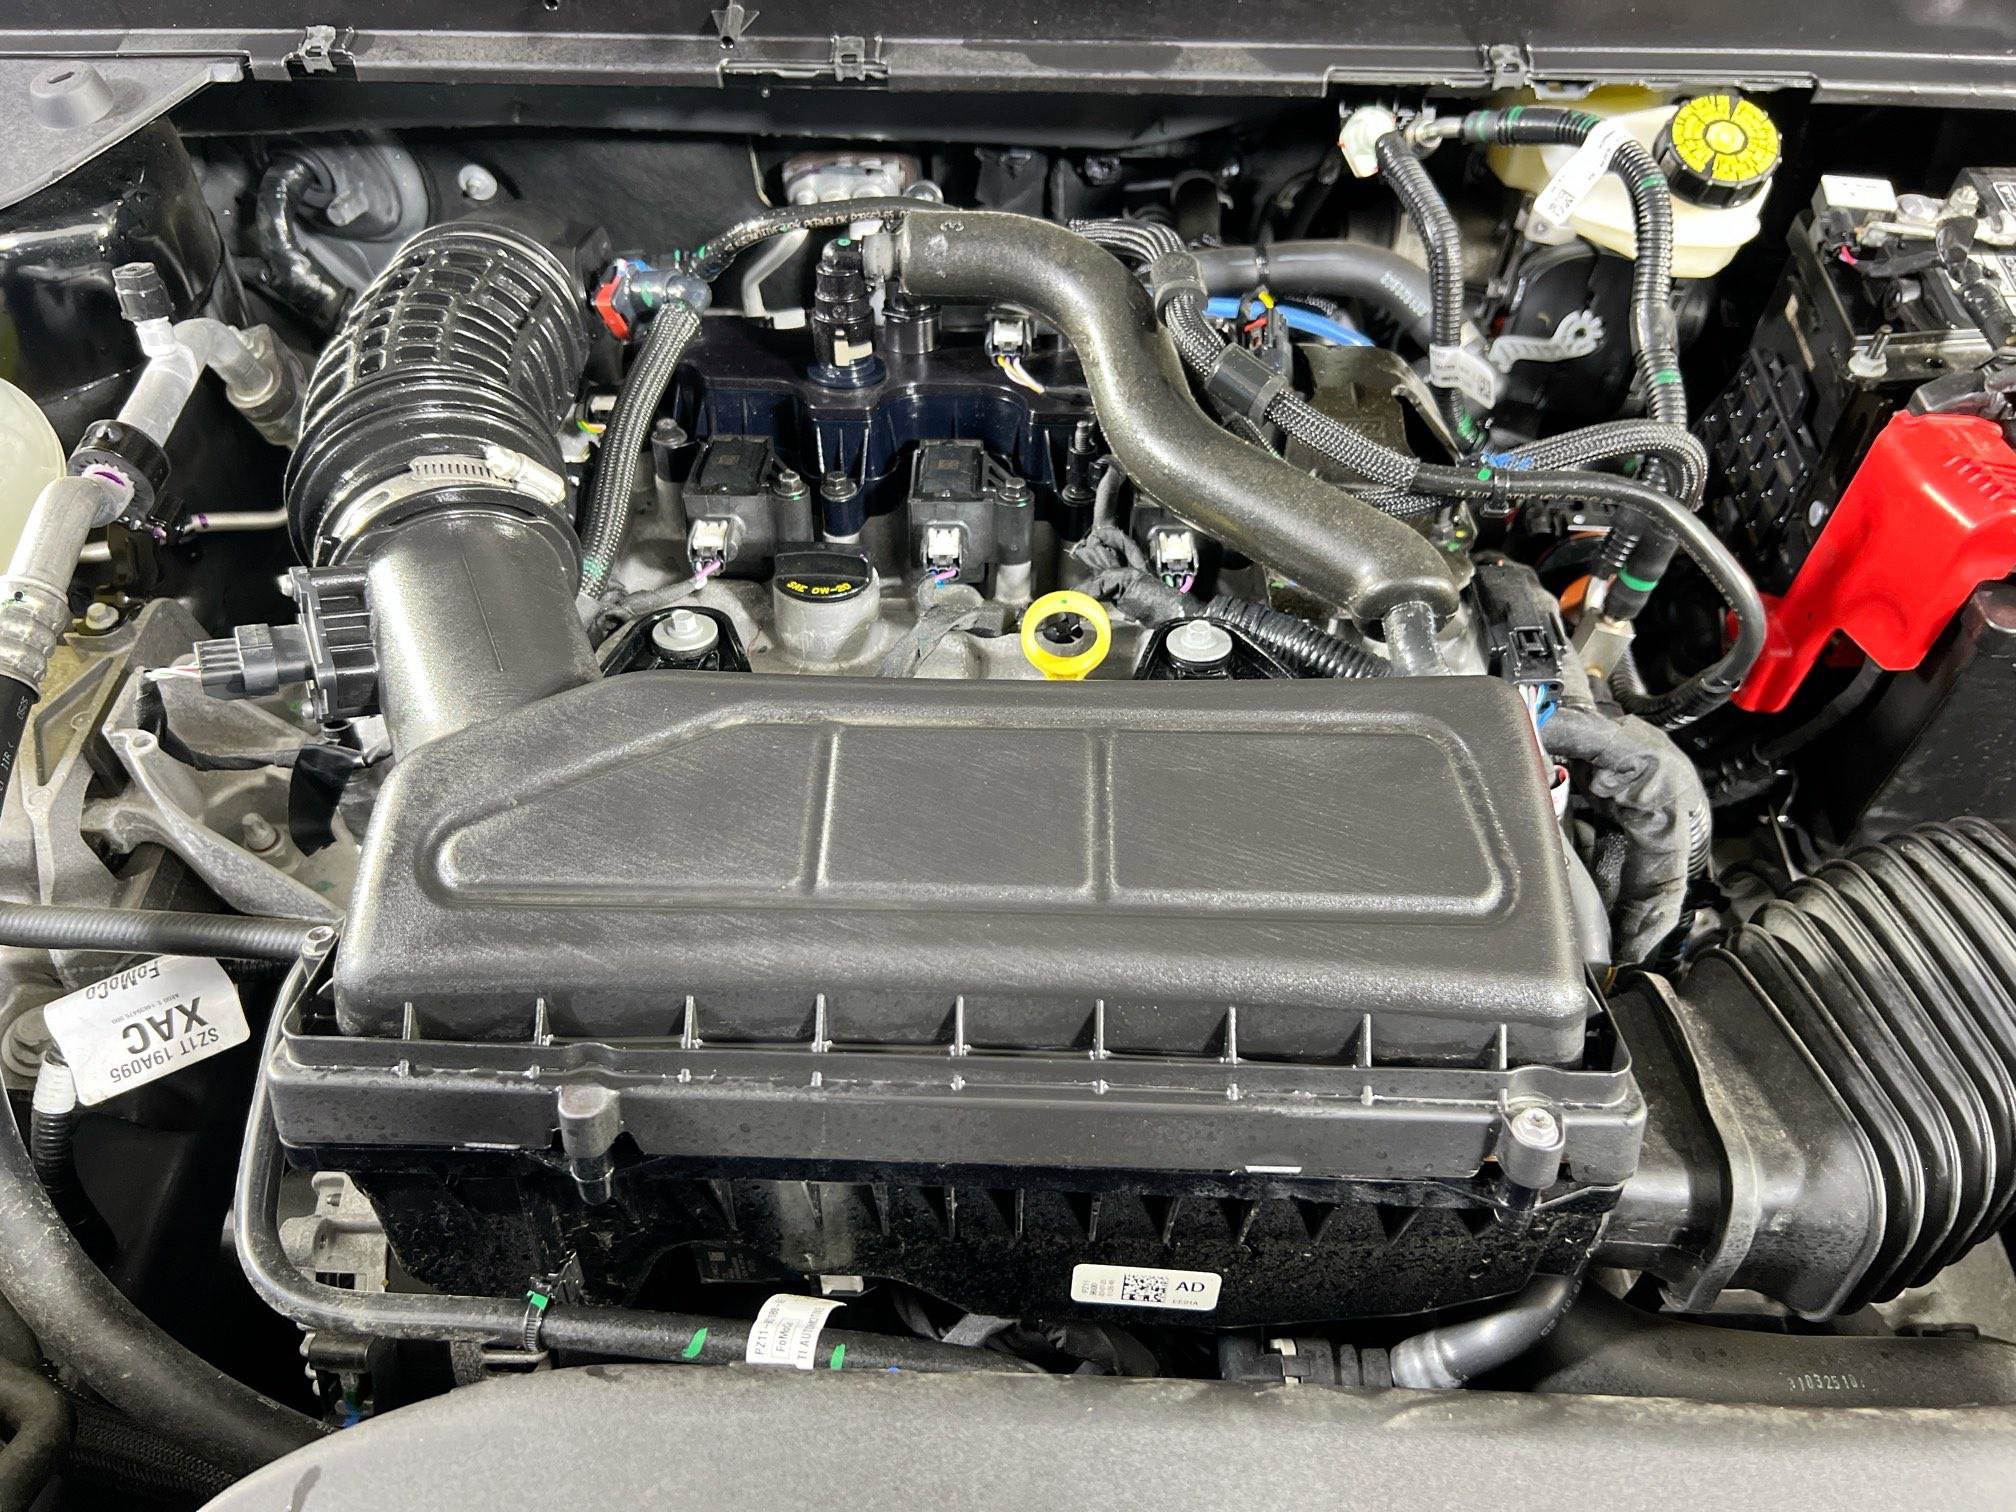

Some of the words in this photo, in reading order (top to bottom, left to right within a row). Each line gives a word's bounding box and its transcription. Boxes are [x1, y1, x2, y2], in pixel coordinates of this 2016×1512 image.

[787, 580, 809, 593] SAE
[85, 959, 160, 1000] FoMoCo
[122, 996, 209, 1055] XAC
[181, 1027, 220, 1055] SZ1T
[110, 1047, 174, 1083] 19A095
[1175, 1281, 1206, 1293] AD
